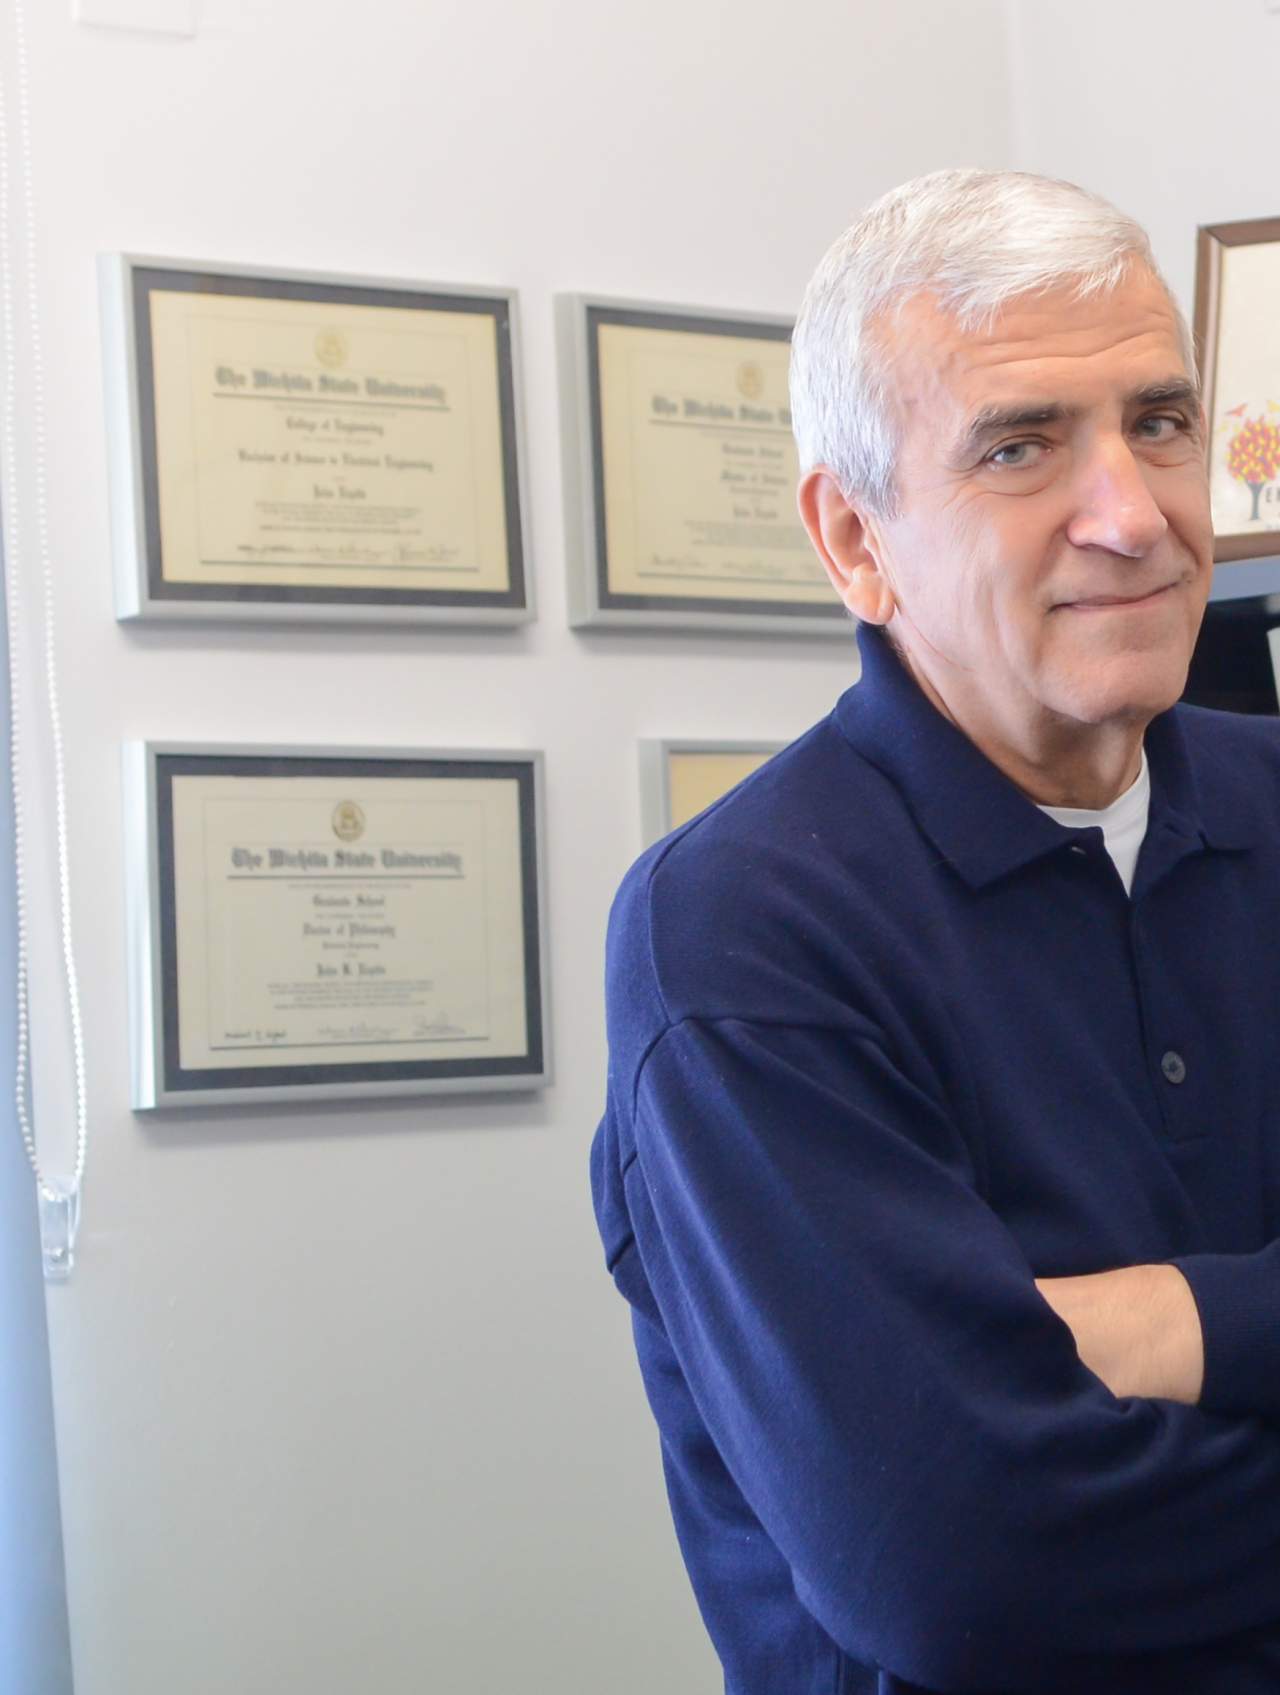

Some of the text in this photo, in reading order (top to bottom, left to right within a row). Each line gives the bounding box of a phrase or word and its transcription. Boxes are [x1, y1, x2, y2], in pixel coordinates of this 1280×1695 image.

[215, 369, 247, 389] The
[317, 376, 360, 395] State
[364, 379, 446, 404] University
[231, 851, 462, 871] The Wichita State University
